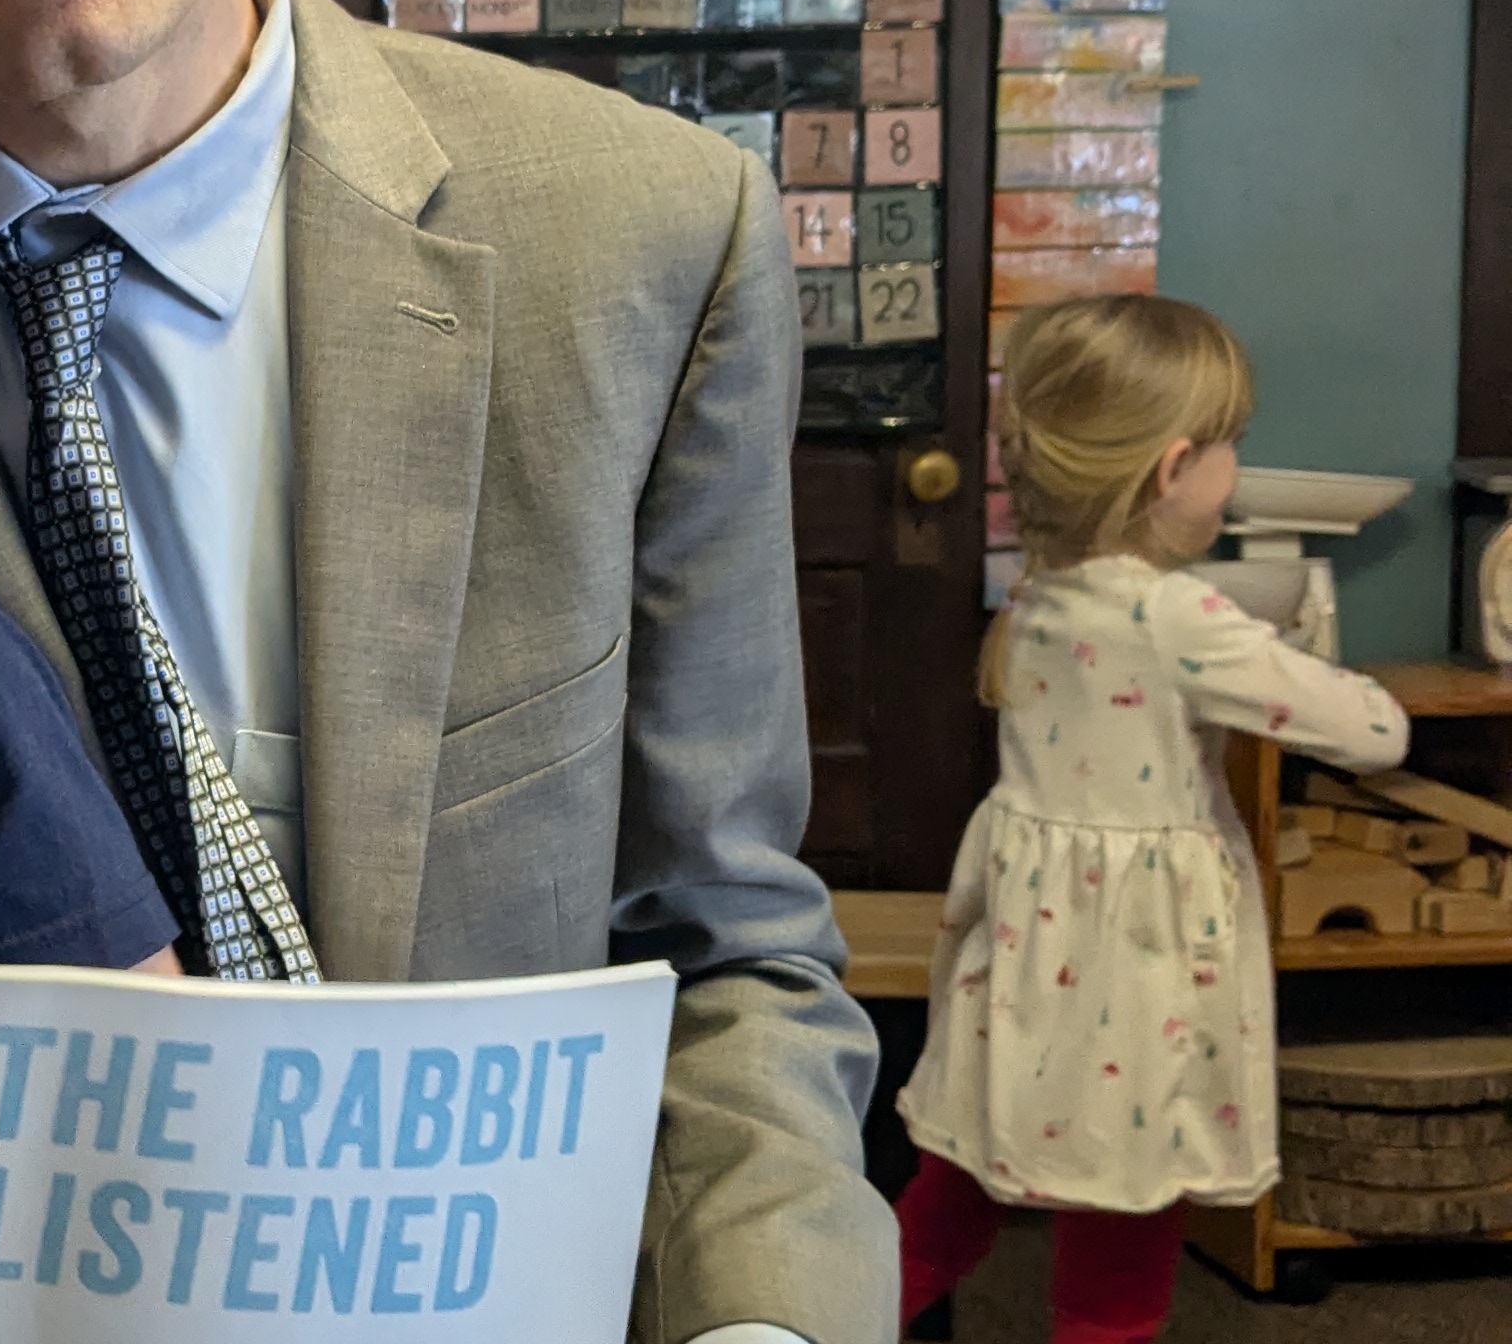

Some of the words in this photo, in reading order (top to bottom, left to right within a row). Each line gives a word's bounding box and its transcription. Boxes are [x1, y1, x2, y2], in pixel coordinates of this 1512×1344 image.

[889, 38, 905, 88] 1
[807, 121, 829, 169] 7
[888, 118, 912, 167] 8
[794, 203, 833, 252] 14
[872, 199, 915, 247] 15
[798, 283, 834, 329] 21
[870, 276, 921, 325] 22
[246, 1032, 606, 1171] RABBIT
